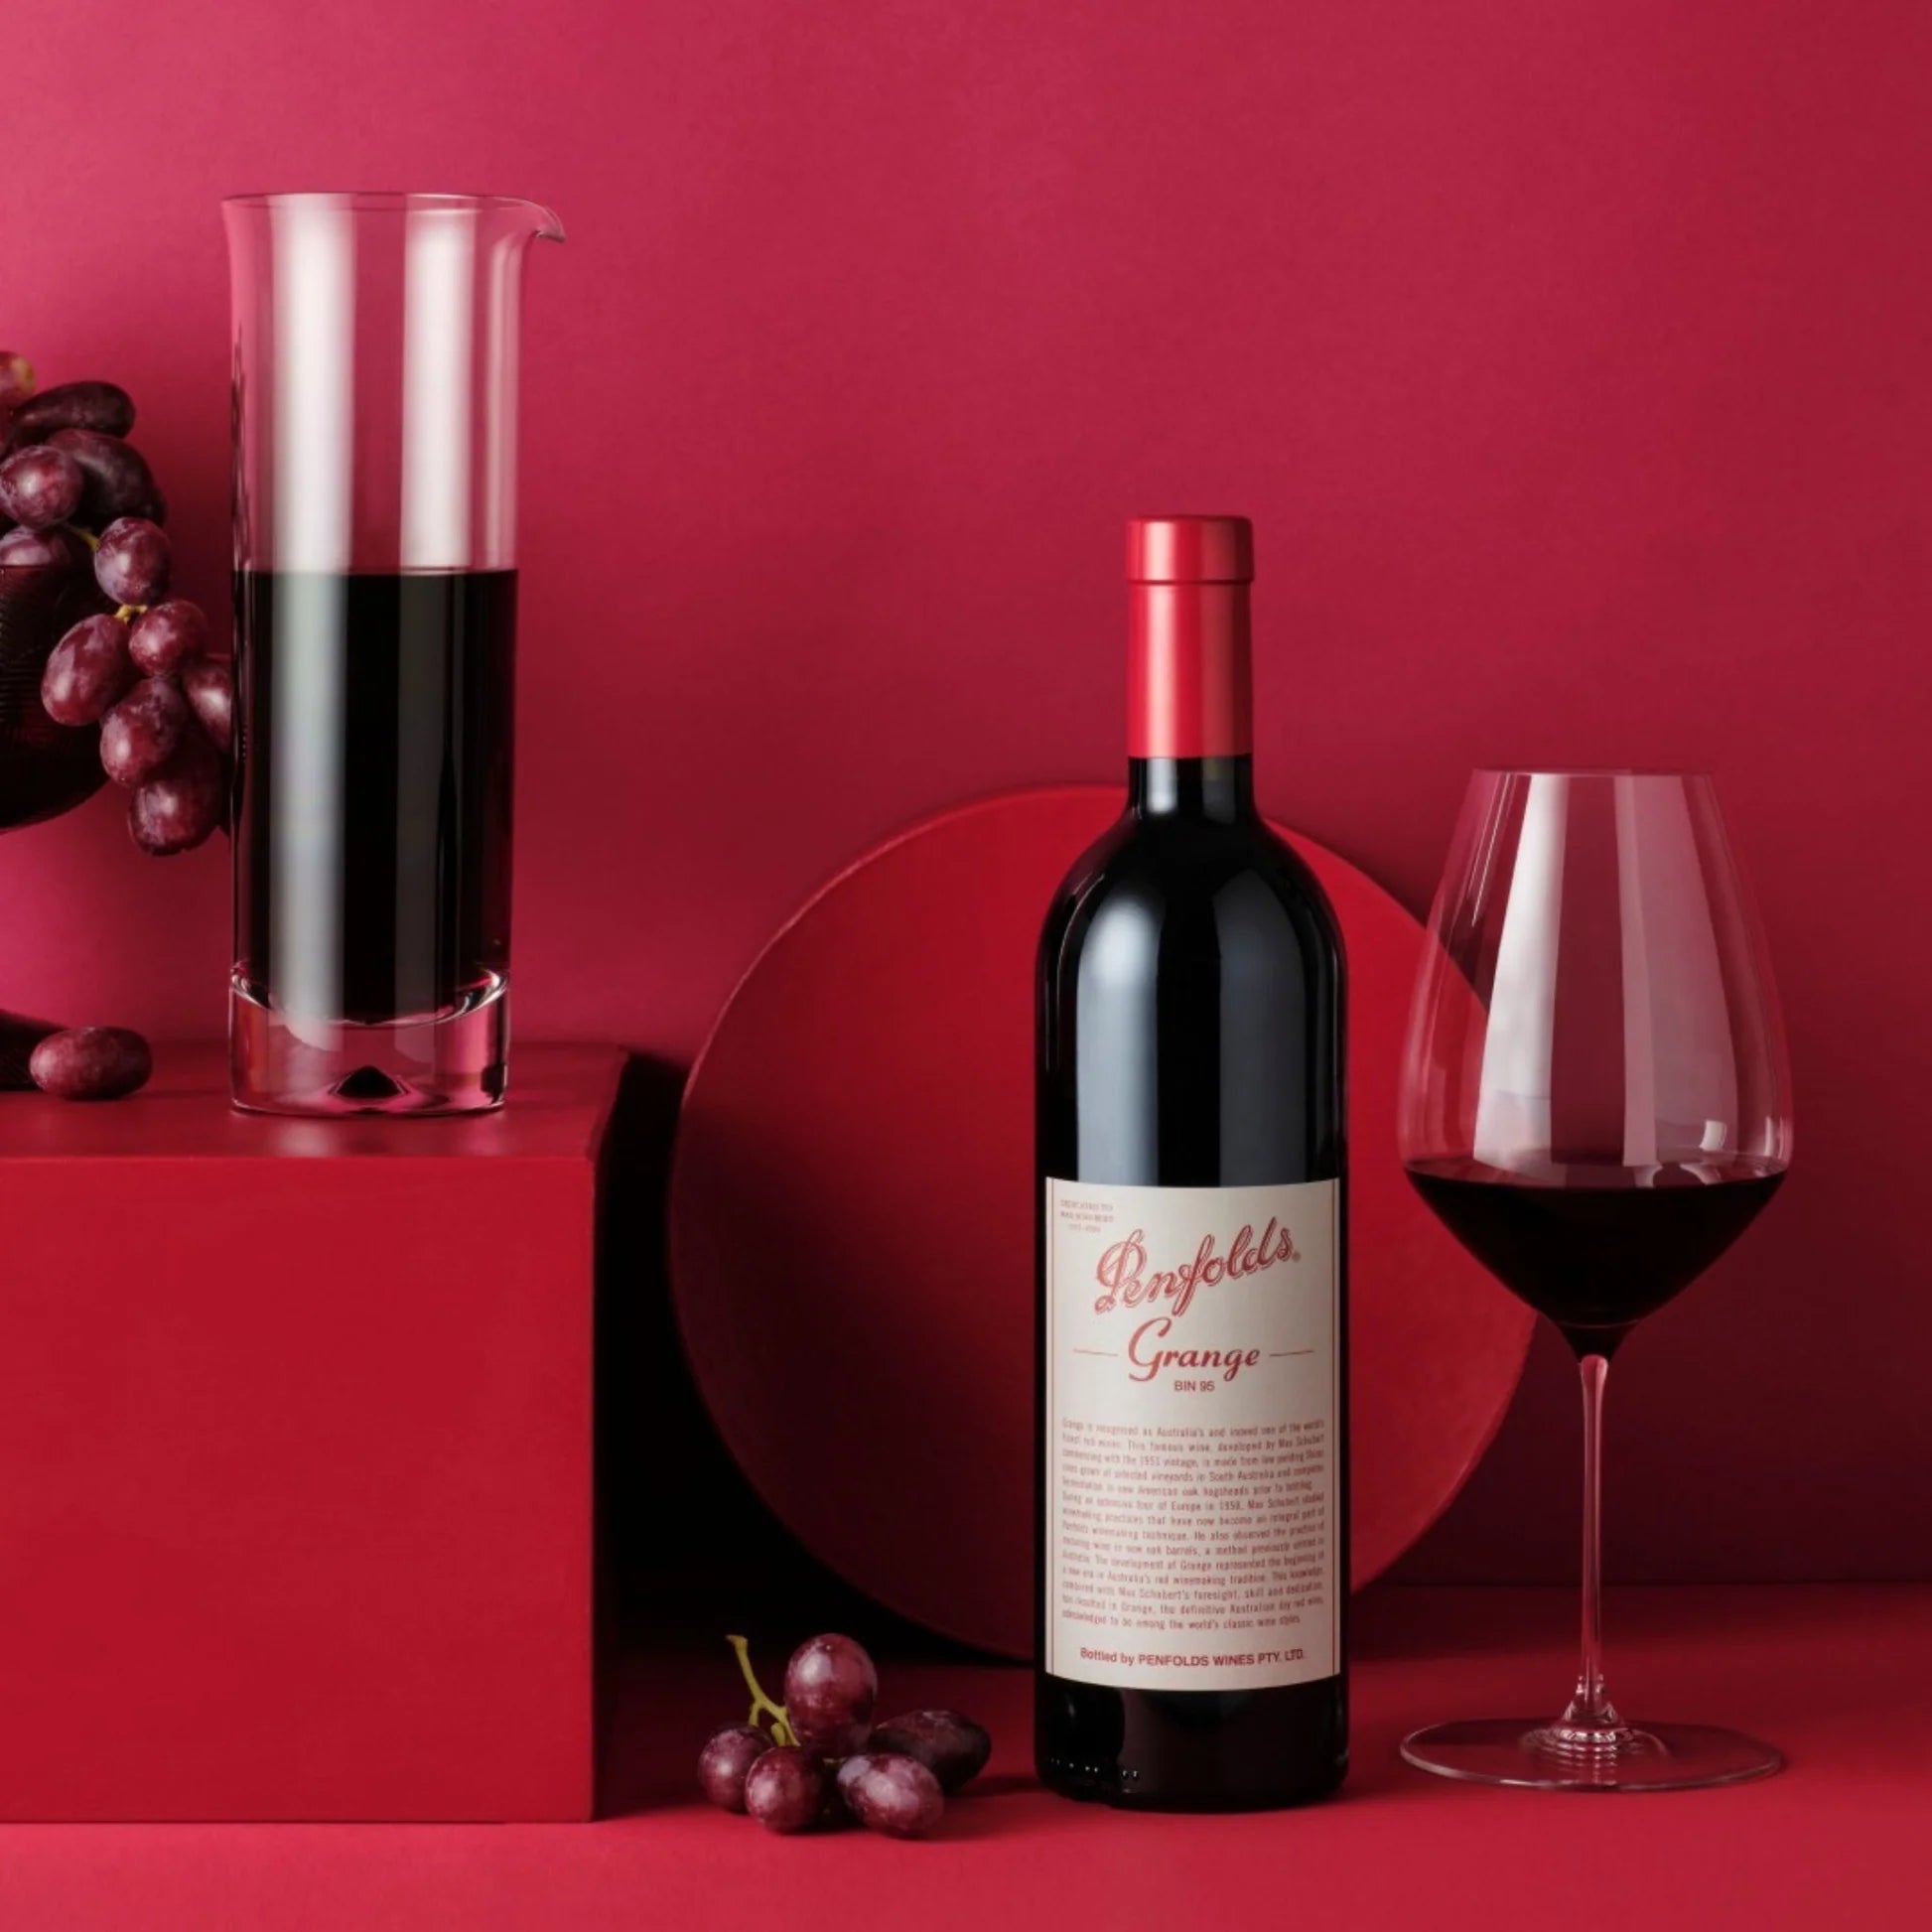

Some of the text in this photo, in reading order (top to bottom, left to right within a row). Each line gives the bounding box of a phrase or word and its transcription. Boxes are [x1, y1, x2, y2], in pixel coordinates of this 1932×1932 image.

[1094, 1216, 1294, 1316] Penfolds
[1128, 1316, 1260, 1382] Grange
[1173, 1380, 1215, 1392] BIN 95
[1080, 1647, 1117, 1663] Bottled
[1121, 1652, 1135, 1666] by
[1139, 1654, 1209, 1666] PENFOLDS
[1213, 1653, 1254, 1666] WINES
